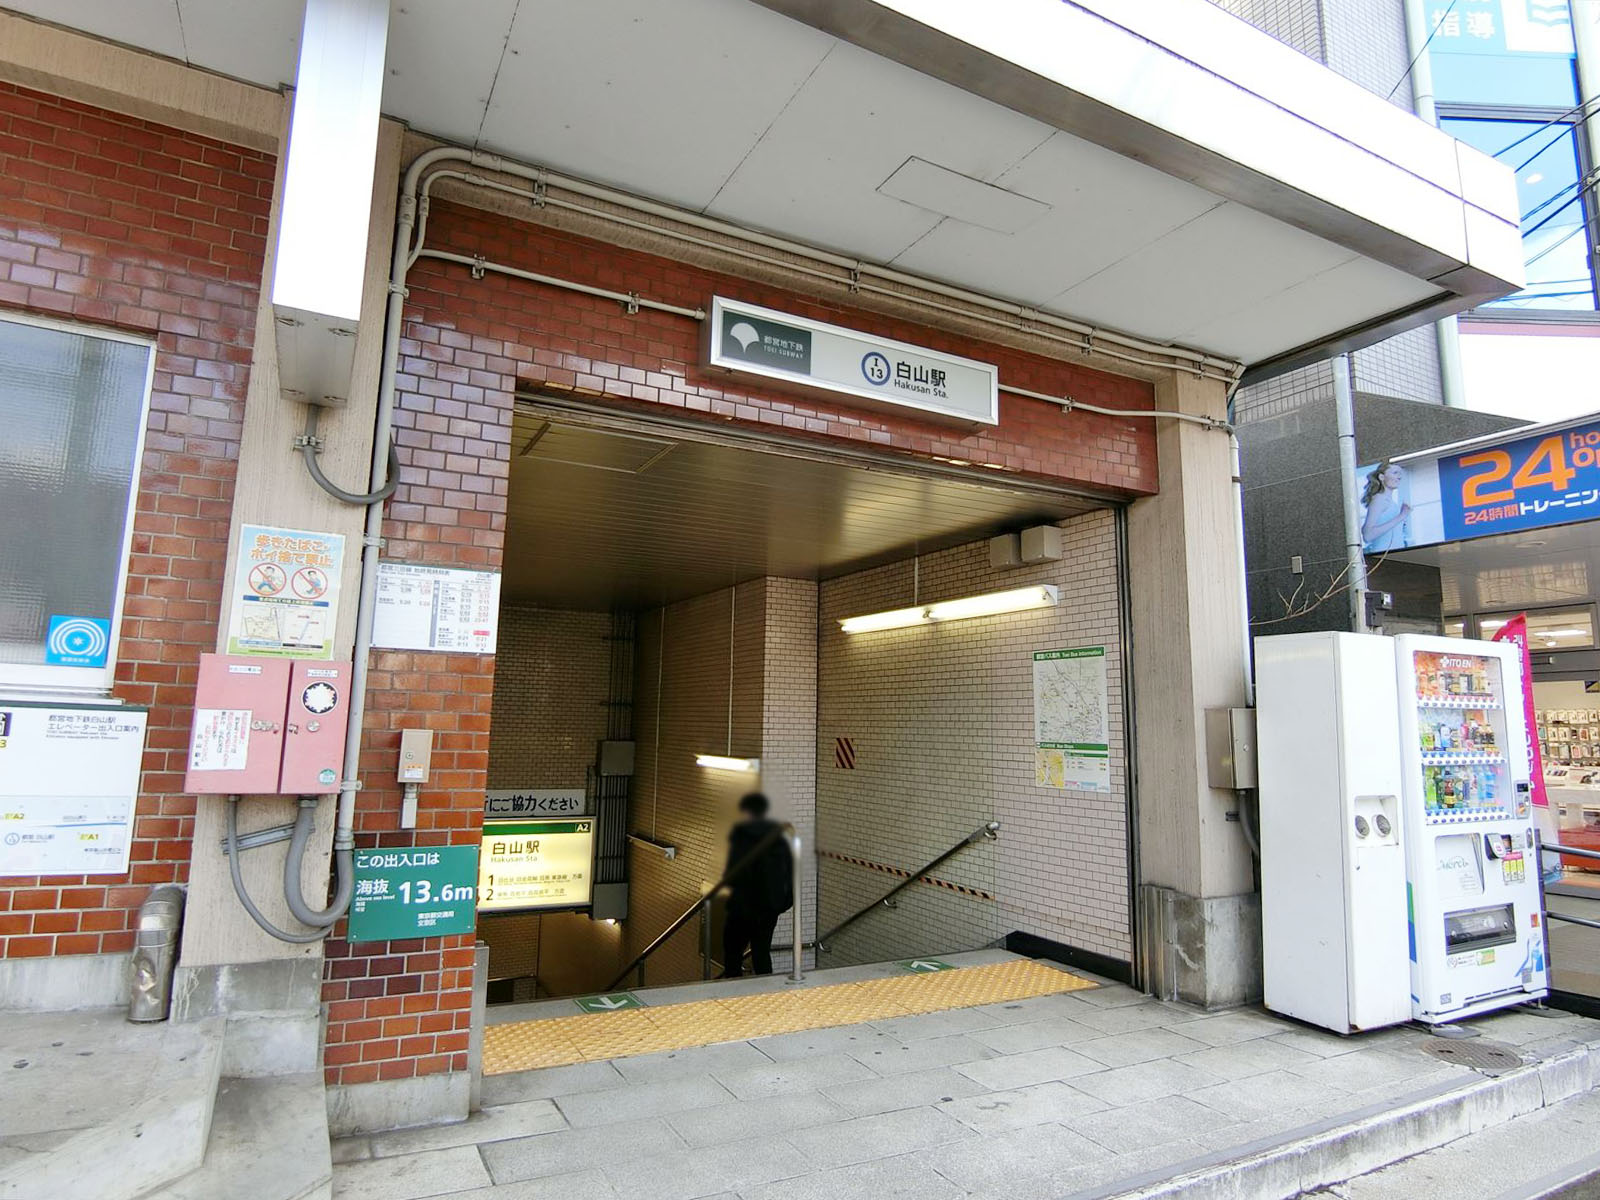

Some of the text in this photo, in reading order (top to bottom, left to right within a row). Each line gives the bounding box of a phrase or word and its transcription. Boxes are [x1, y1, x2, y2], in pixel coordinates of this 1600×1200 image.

[763, 335, 804, 352] 都営地下鉄
[874, 358, 879, 367] I
[870, 367, 884, 379] 13
[896, 361, 946, 388] 白山駅
[894, 379, 949, 399] Hakusan Sta.
[1572, 447, 1600, 468] O
[1459, 435, 1576, 508] 24
[1464, 488, 1600, 526] 24時間トレーニン
[1449, 658, 1472, 669] ITO EN
[48, 714, 116, 724] 都営地下鉄白山駅
[48, 723, 140, 733] エレベーター出入口案内
[577, 824, 590, 832] A2
[492, 840, 540, 855] 白山駅
[356, 852, 440, 869] この出入口は
[491, 856, 524, 864] Hakusan
[488, 874, 494, 886] 1
[355, 879, 473, 905] 海抜 13.6m
[486, 889, 494, 901] 2
